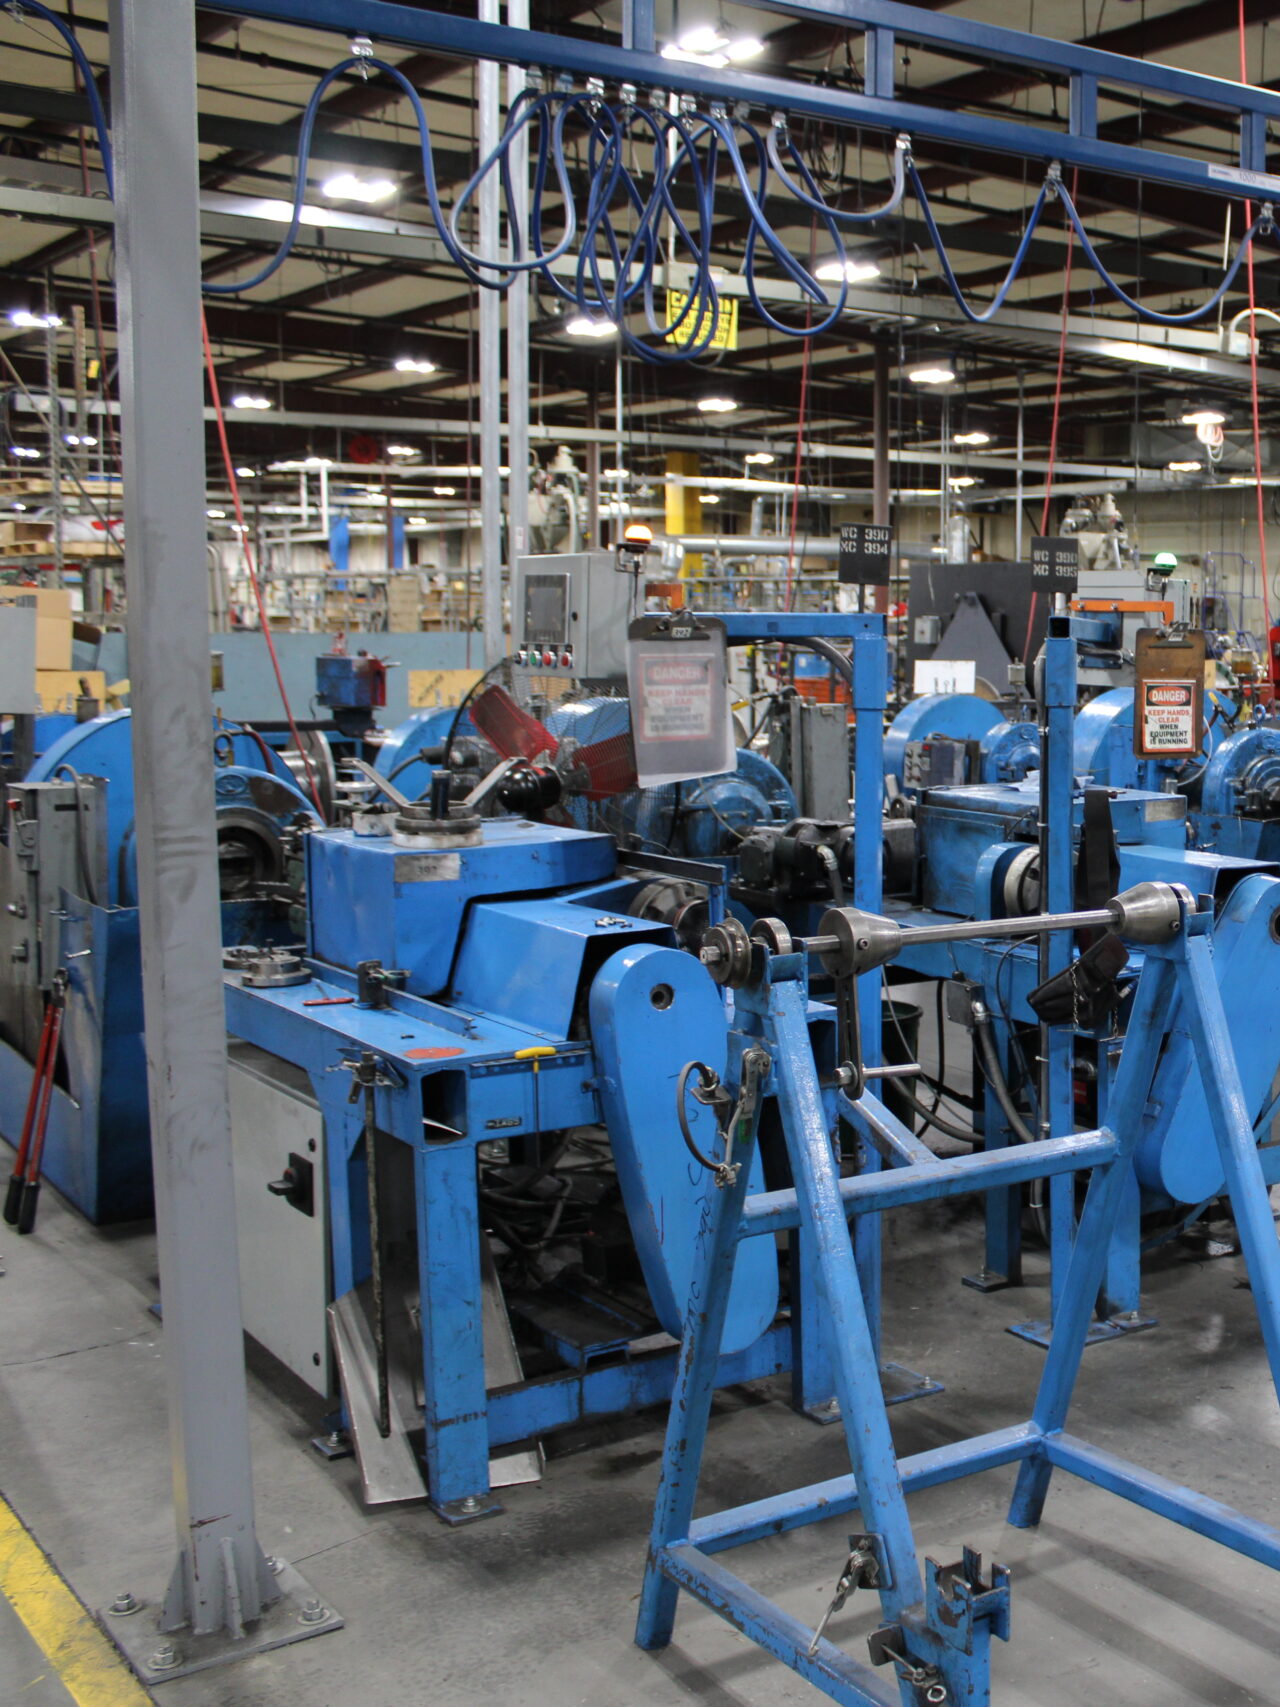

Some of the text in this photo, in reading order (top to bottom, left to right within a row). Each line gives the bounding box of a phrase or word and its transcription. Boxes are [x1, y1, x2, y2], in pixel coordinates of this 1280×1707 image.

[841, 526, 889, 541] WC 390
[840, 541, 888, 555] MC 394
[1034, 550, 1078, 564] WC 390
[1055, 565, 1078, 578] 395
[654, 666, 701, 680] DANGER
[1152, 690, 1186, 702] DANGER
